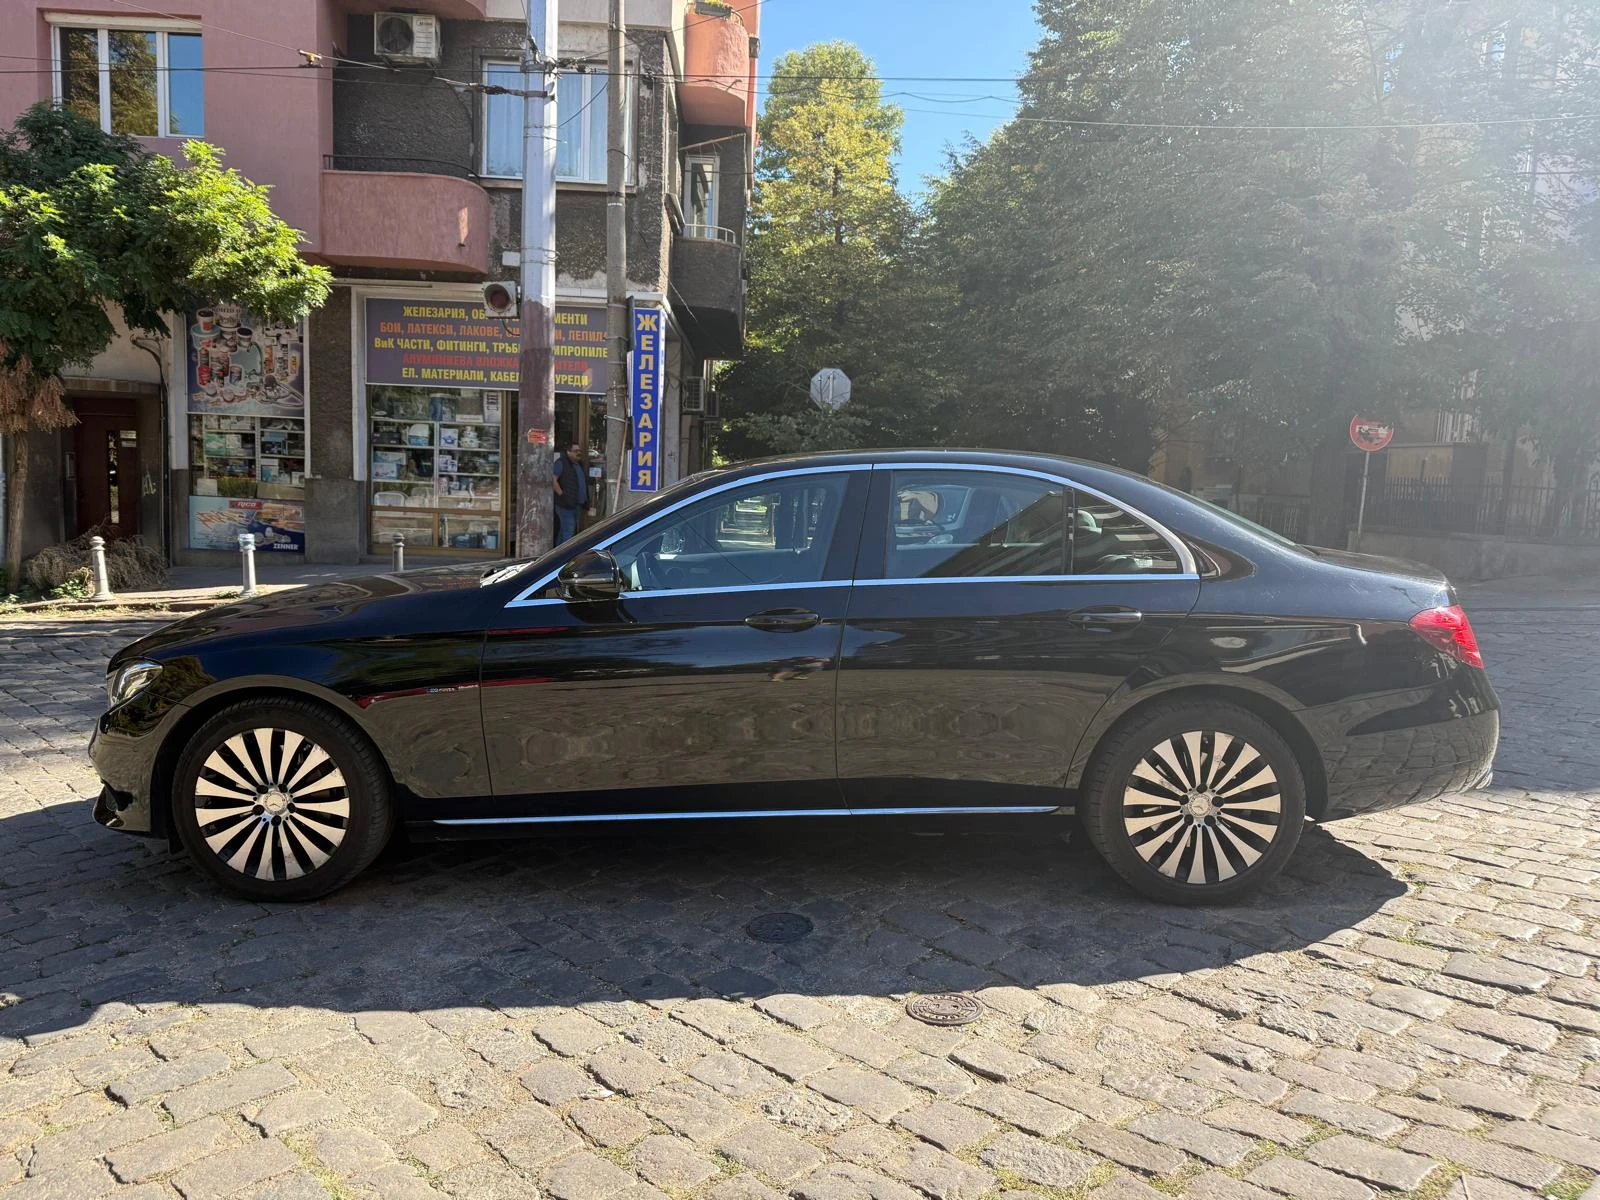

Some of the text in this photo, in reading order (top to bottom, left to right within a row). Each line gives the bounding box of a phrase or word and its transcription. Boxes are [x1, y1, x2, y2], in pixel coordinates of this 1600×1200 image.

[403, 305, 469, 321] ЖЕЛЕЗАРИЯ,
[407, 323, 457, 337] ЛАТЕКСИ,
[459, 325, 502, 339] ЛАКОВЕ,
[374, 337, 394, 349] ВиК
[397, 338, 434, 352] ЧАСТИ,
[436, 339, 490, 354] ФИТИНГИ,
[492, 342, 520, 354] ТРЪБ
[402, 367, 418, 378] ЕЛ.
[421, 368, 488, 383] МАТЕРИАЛИ,
[637, 313, 658, 486] ЖЕЛЕЗАРИЯ
